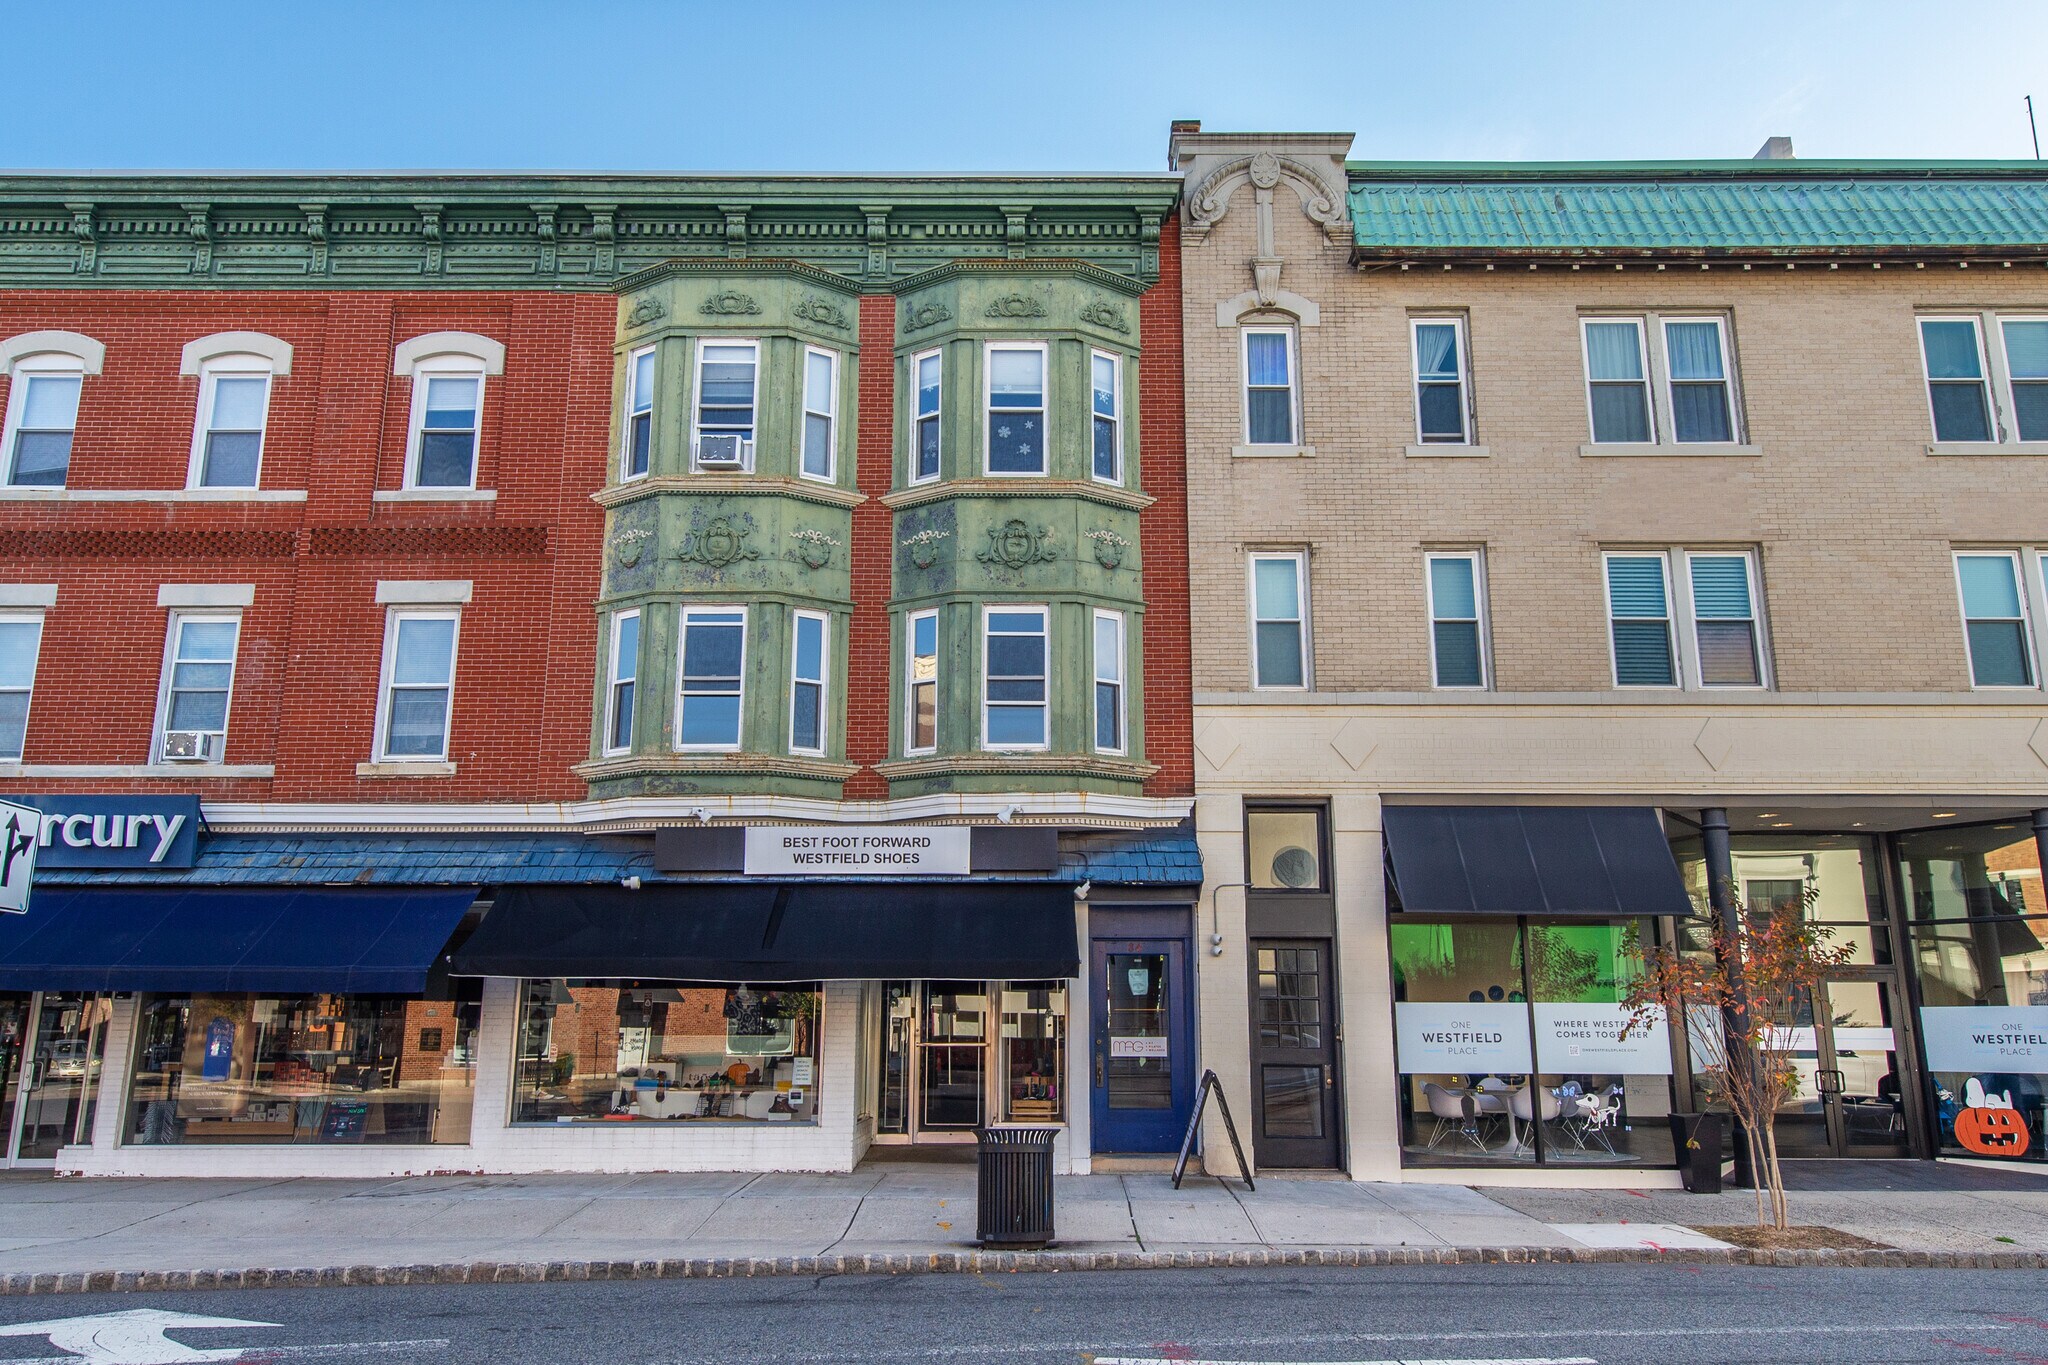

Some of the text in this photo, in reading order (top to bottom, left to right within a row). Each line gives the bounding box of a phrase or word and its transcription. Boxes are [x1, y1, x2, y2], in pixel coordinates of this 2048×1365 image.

[783, 836, 931, 849] BEST FOOT FORWARD
[793, 852, 920, 865] WESTFIELD SHOES
[1450, 1021, 1471, 1029] ONE
[1553, 1020, 1649, 1028] WHERE WESTFLD
[2001, 1023, 2024, 1031] ONE
[1422, 1032, 1503, 1043] WESTFIELD
[1555, 1031, 1649, 1039] COMES TOGEHER
[1112, 1040, 1144, 1053] MAG
[1447, 1047, 1478, 1055] PLACE
[2000, 1048, 2033, 1056] PLACE
